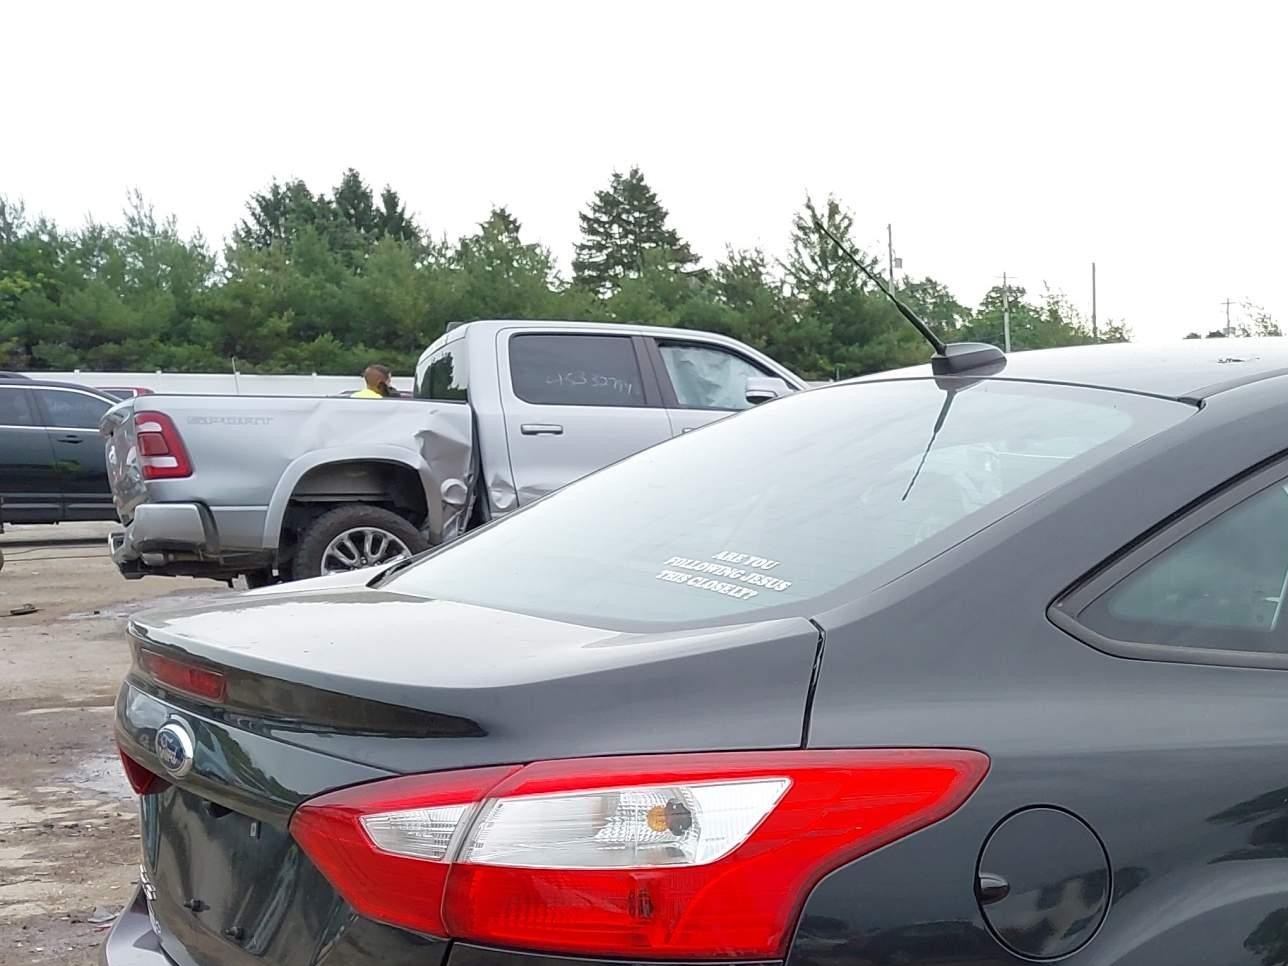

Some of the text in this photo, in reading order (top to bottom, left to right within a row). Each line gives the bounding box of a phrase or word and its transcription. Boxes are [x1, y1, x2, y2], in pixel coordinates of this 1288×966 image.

[711, 550, 781, 570] ARE YOU
[655, 570, 692, 583] THIS
[663, 556, 793, 592] FOLLOWING JESUS
